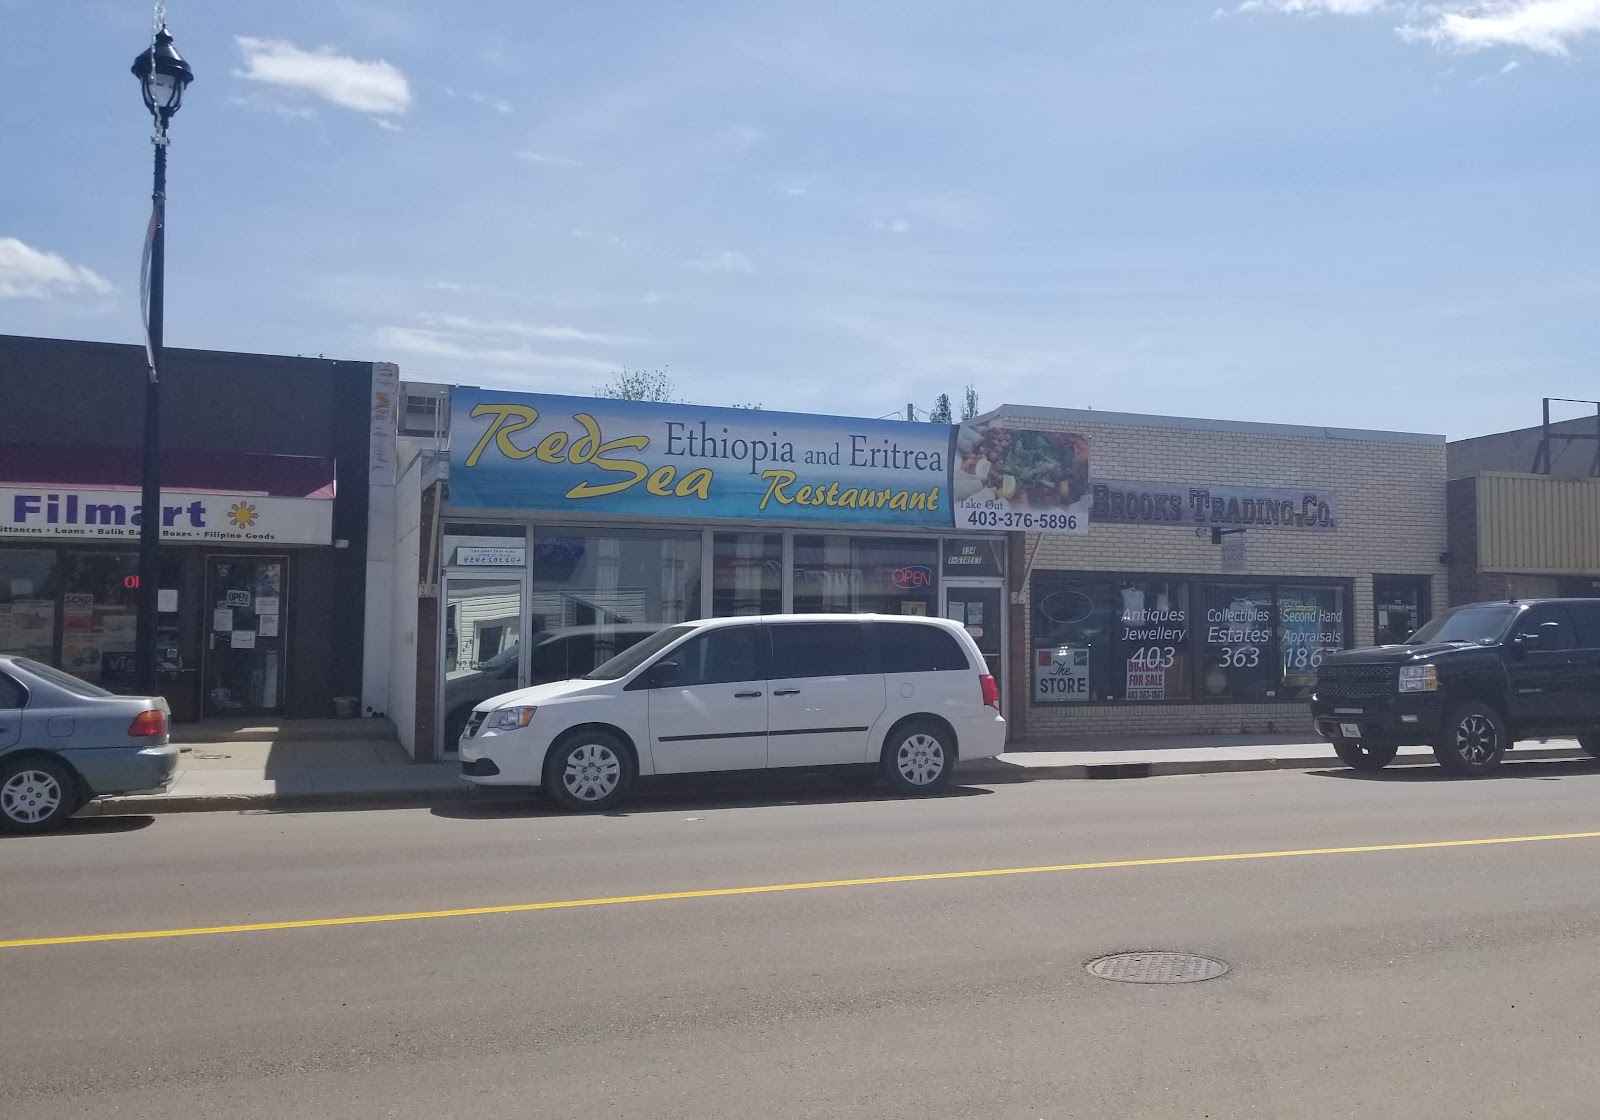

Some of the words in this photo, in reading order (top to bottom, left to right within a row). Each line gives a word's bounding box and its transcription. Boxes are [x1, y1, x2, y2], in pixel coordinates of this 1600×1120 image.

[465, 403, 601, 467] Red
[565, 436, 713, 500] Sea
[664, 421, 796, 474] Ethiopia
[804, 443, 840, 466] and
[848, 435, 943, 472] Eritrea
[759, 470, 940, 511] Restaurant
[959, 499, 982, 509] Take
[985, 500, 1003, 510] Out
[1091, 484, 1182, 522] BROOKS
[968, 510, 1077, 530] 403-376-5896
[55, 527, 85, 535] Loans
[98, 528, 124, 536] Balik
[204, 531, 241, 540] Filipino
[246, 532, 275, 540] Goods
[892, 569, 931, 586] OPEN
[228, 592, 249, 602] OPEN
[1121, 608, 1185, 624] Antiques
[1207, 608, 1269, 622] Collectibles
[1283, 609, 1317, 622] Second
[1319, 609, 1342, 622] Hand
[1122, 626, 1186, 642] Jewellery
[1207, 626, 1269, 642] Estates
[1282, 630, 1341, 645] Appraisals
[1131, 647, 1175, 668] 403
[1219, 647, 1260, 668] 363
[1287, 648, 1338, 668] 186
[1049, 660, 1073, 676] The
[1040, 677, 1086, 693] STORE
[1129, 674, 1143, 686] FOR
[1145, 674, 1163, 686] SALE
